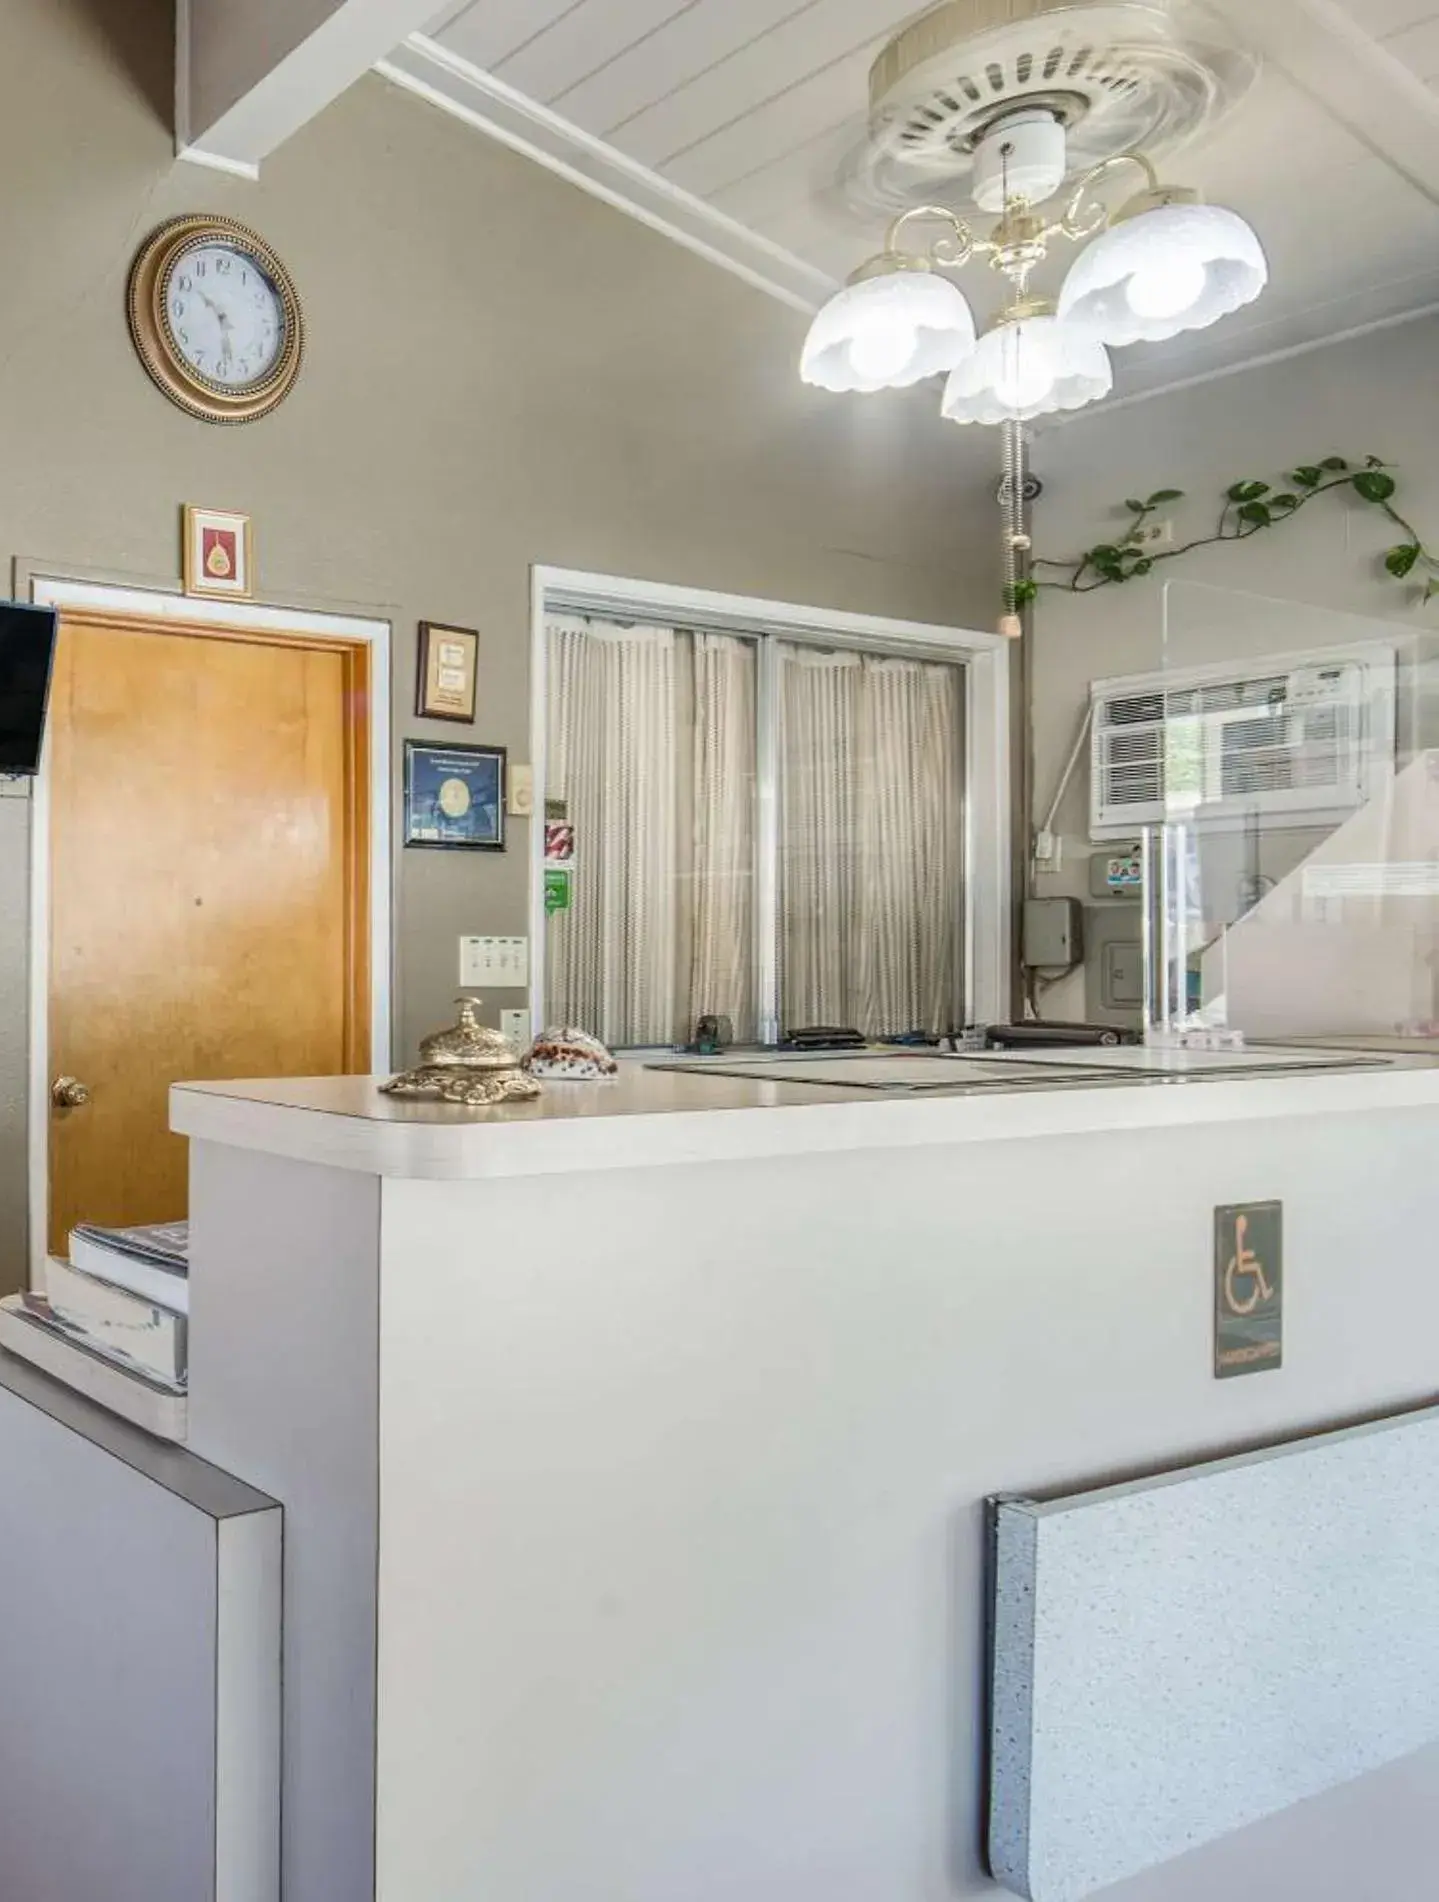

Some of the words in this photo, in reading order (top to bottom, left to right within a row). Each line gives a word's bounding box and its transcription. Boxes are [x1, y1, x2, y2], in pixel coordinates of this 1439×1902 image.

[196, 261, 206, 277] 11
[216, 259, 230, 275] 12
[179, 275, 192, 292] 10
